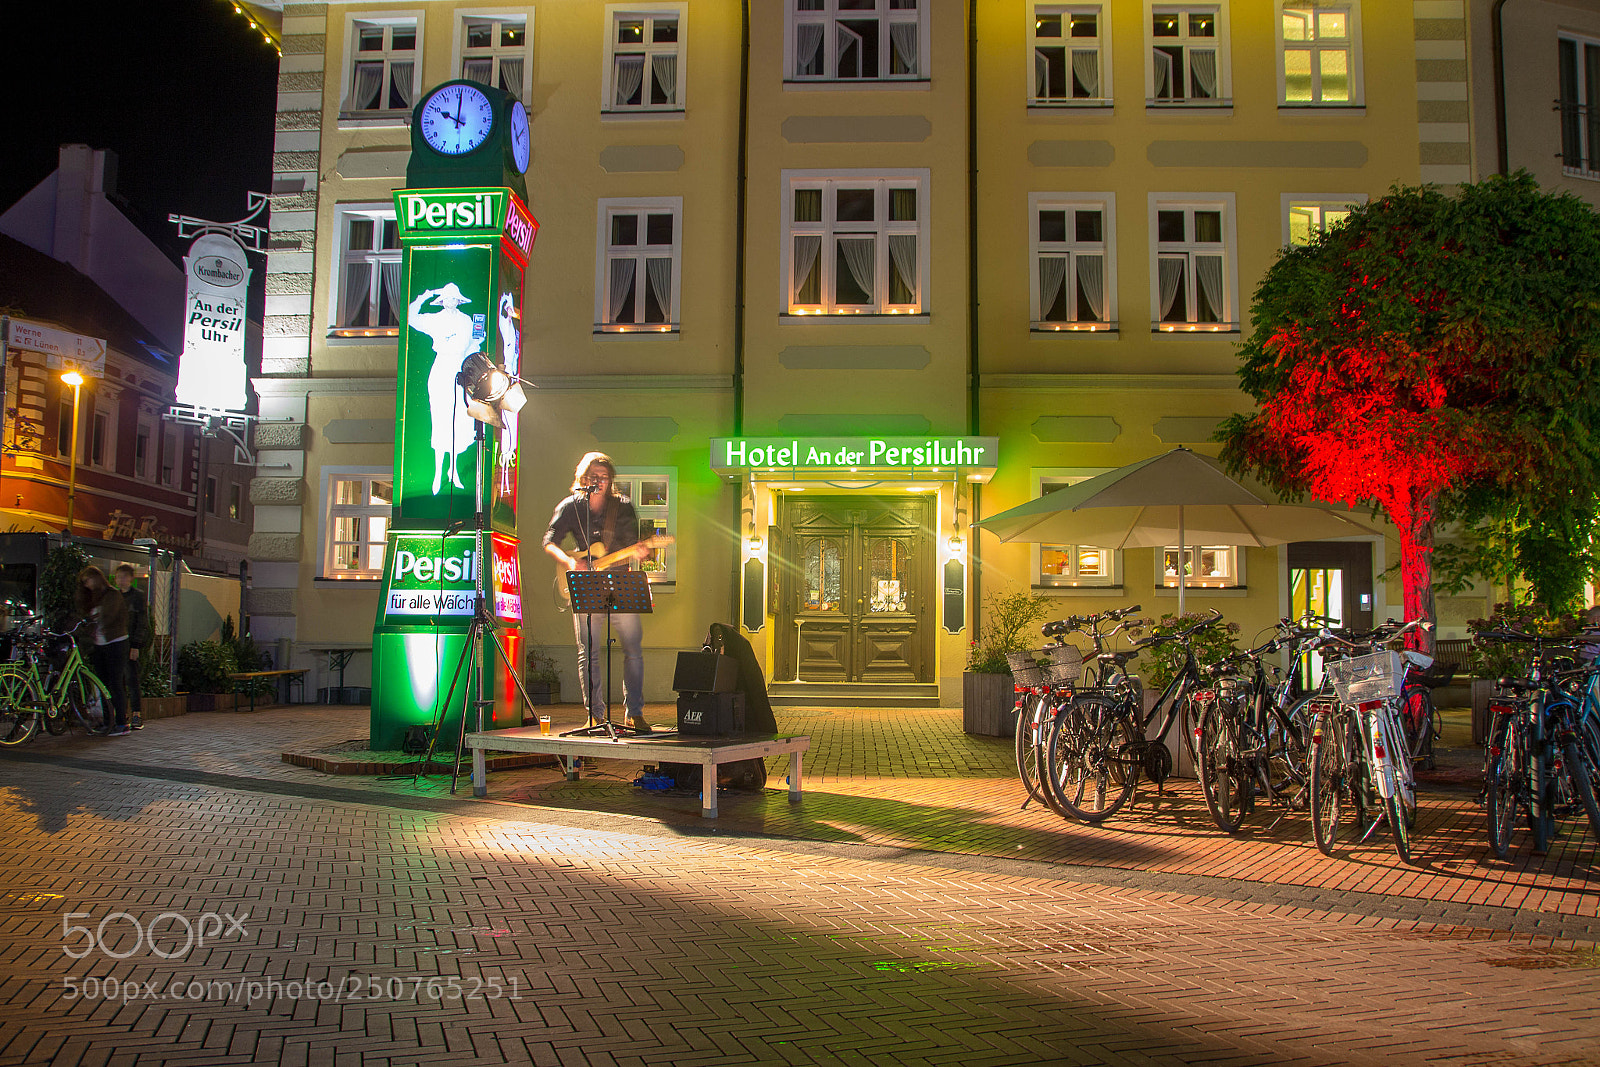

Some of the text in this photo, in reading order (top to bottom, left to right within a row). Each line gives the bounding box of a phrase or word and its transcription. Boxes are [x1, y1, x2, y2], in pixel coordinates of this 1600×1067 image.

[407, 195, 492, 227] Persil
[505, 200, 533, 253] Persil
[198, 265, 241, 281] Krombacher
[194, 300, 239, 315] An der
[189, 312, 242, 332] Persil
[15, 324, 42, 338] Werne
[201, 329, 228, 342] Uhr
[34, 339, 59, 352] Lünen
[726, 440, 985, 467] Hotel An der Persiluhr
[493, 552, 517, 586] Persil
[390, 594, 407, 609] für
[409, 594, 430, 609] alle
[684, 708, 704, 722] AER
